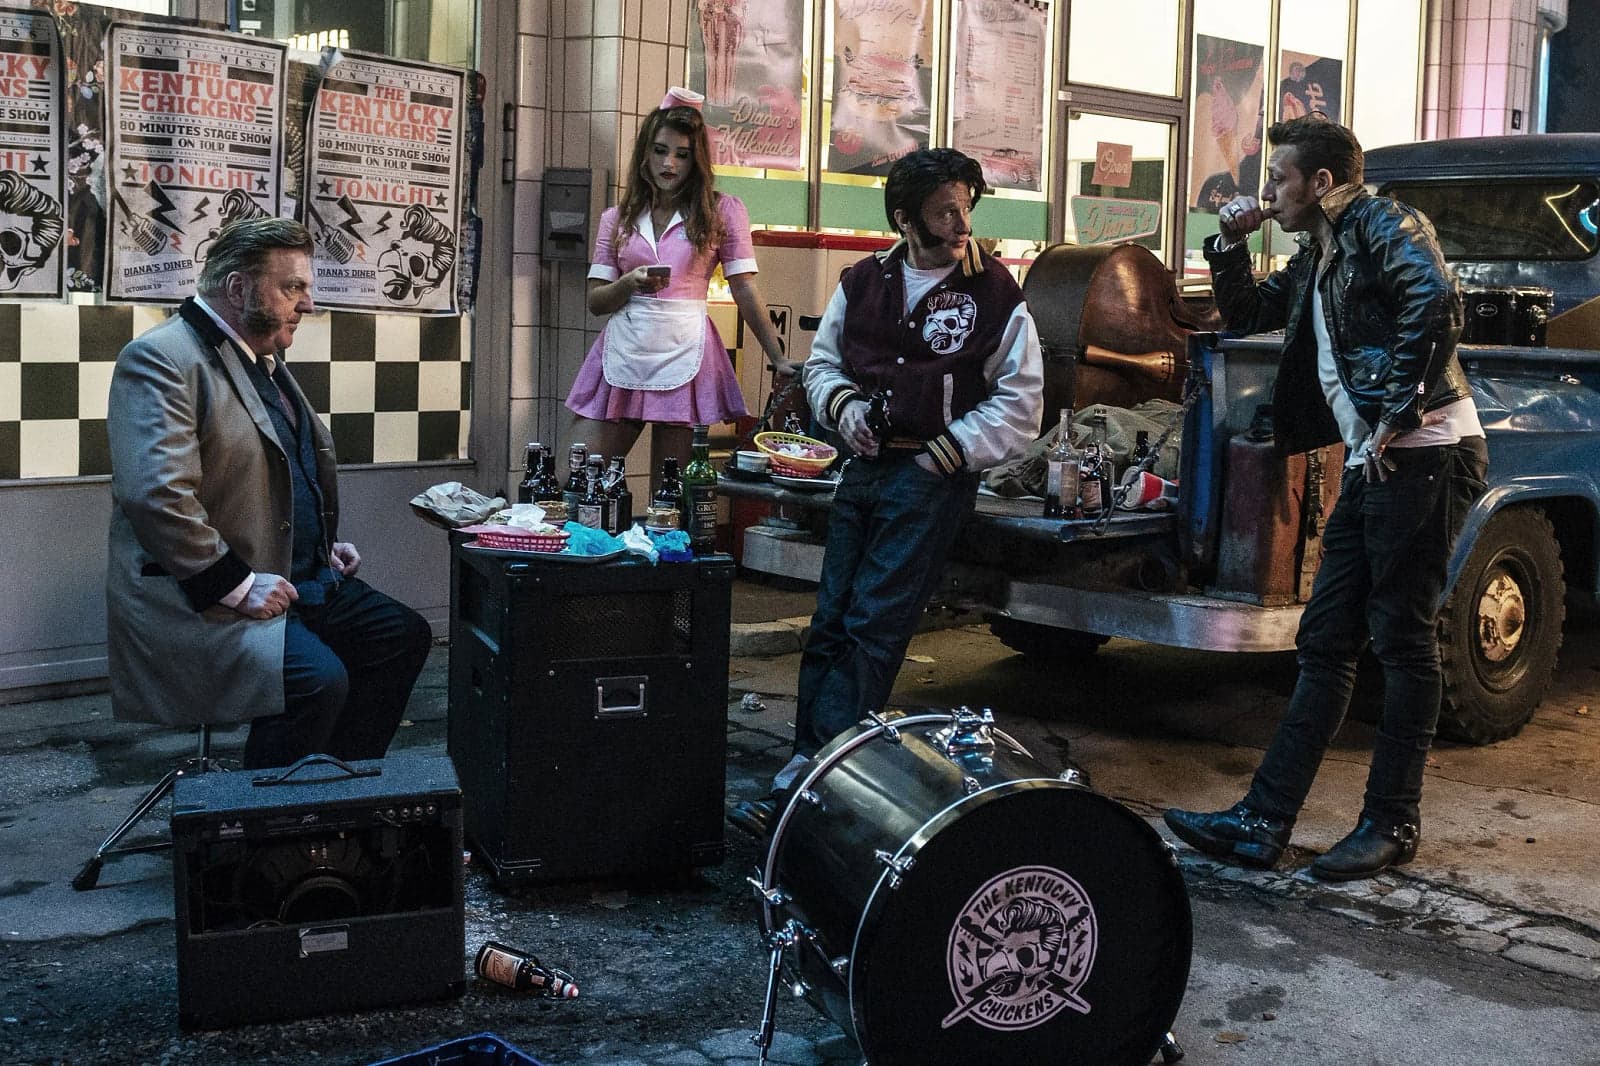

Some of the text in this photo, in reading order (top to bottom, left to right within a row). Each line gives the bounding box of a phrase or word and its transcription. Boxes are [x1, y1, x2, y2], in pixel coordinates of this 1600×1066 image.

[120, 42, 191, 58] DON'T
[186, 61, 222, 77] THE
[120, 69, 274, 106] KENTUCKY
[374, 86, 406, 101] THE
[9, 109, 50, 121] SHOW
[141, 94, 256, 122] CHICKENS
[319, 90, 453, 128] KENTUCKY
[730, 96, 797, 130] Diana's
[120, 120, 273, 145] 80 MINUTES STAGE SHOW
[338, 115, 437, 144] CHICKENS
[713, 125, 794, 157] Milkshake
[178, 138, 225, 152] ON TOUR
[319, 138, 451, 164] 80 MINUTES STAGE SHOW
[139, 163, 255, 190] TONIGHT
[365, 157, 408, 170] ON TOUR
[1099, 150, 1128, 180] Open
[333, 179, 434, 206] TONIGHT
[1081, 202, 1153, 243] Diana's
[124, 260, 193, 277] DIANA'S DINER
[317, 268, 377, 279] DIANA'S DINER
[125, 284, 153, 293] OCTOBER
[973, 874, 1081, 919] THE KENTUCKY
[979, 993, 1054, 1021] CHICKENS
